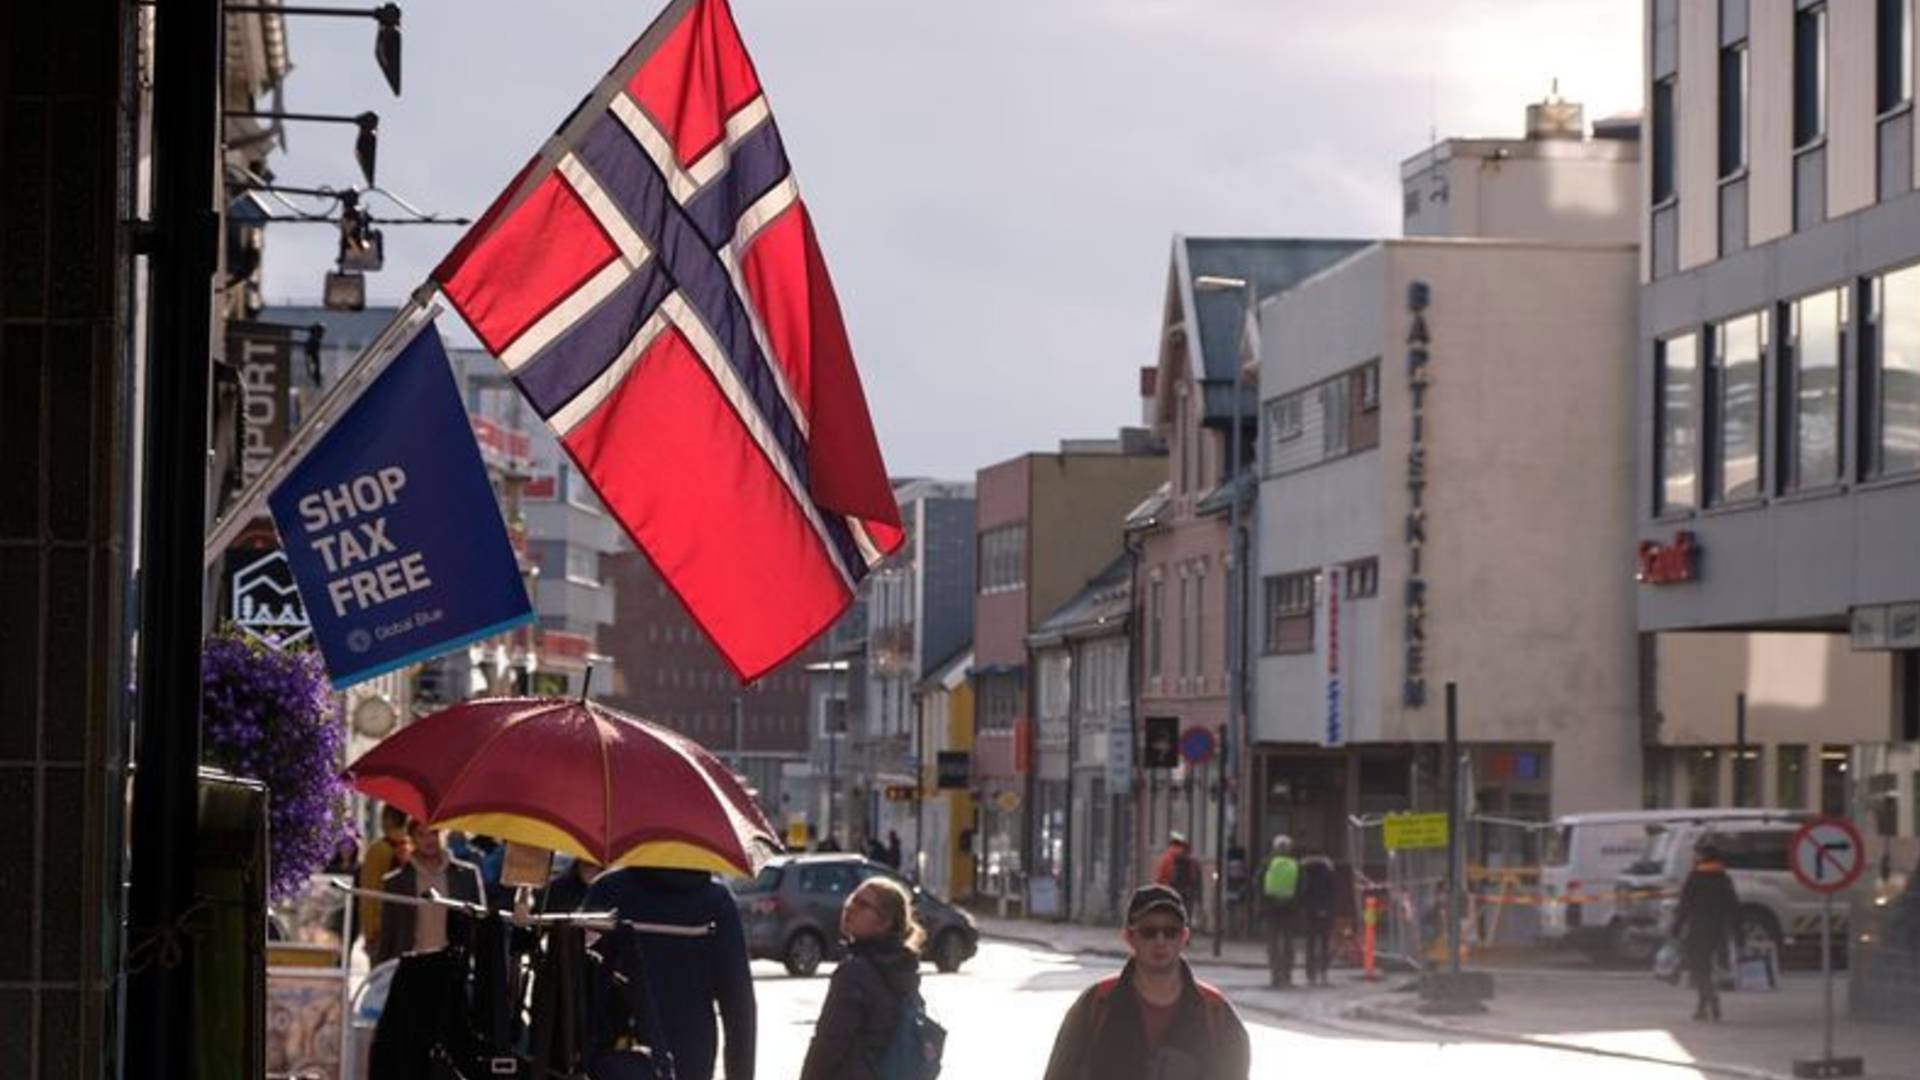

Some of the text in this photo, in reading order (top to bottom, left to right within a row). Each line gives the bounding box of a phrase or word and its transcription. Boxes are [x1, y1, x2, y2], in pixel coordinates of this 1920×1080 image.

[299, 466, 406, 532] SHOP
[1403, 281, 1431, 711] BAPTISTKIRKEN
[311, 517, 397, 572] TAX
[327, 552, 432, 618] FREE
